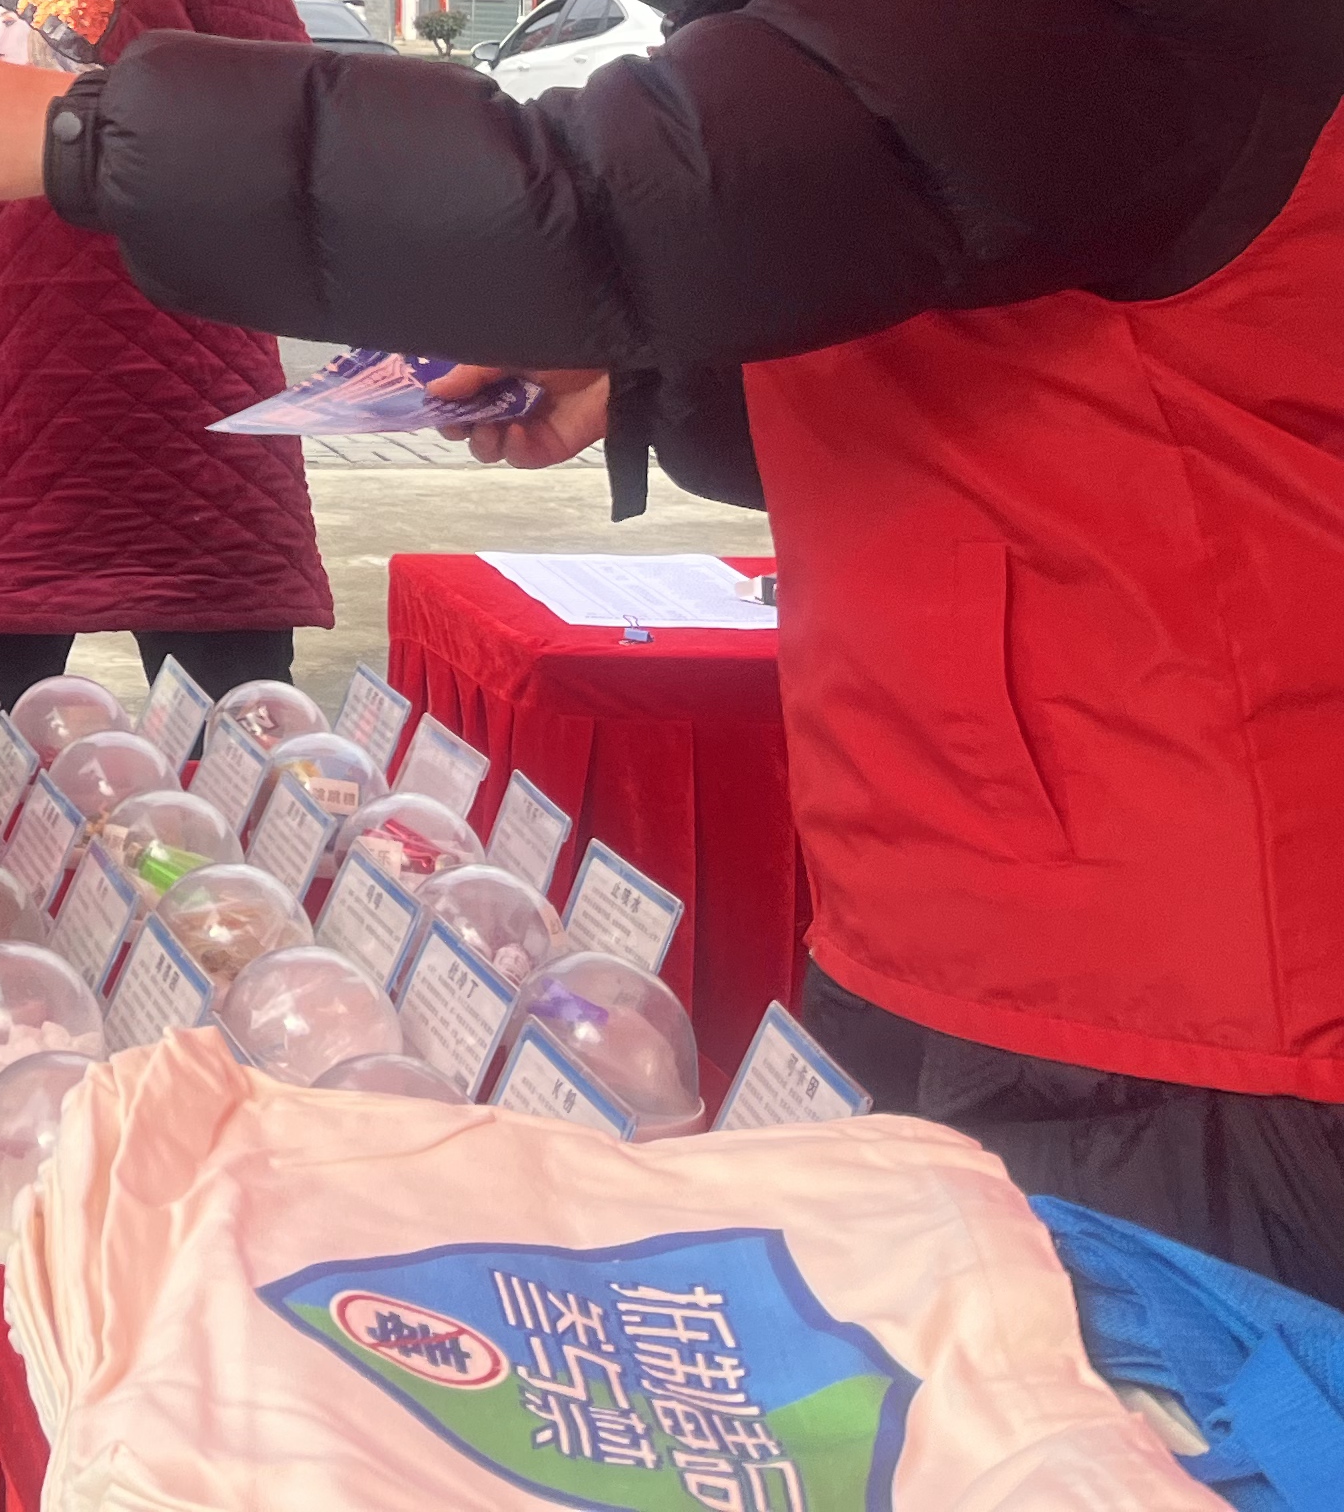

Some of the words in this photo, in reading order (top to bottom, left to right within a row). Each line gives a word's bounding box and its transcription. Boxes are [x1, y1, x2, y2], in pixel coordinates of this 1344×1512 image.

[448, 960, 479, 999] 杜冷丁
[787, 1053, 820, 1100] 可卡因
